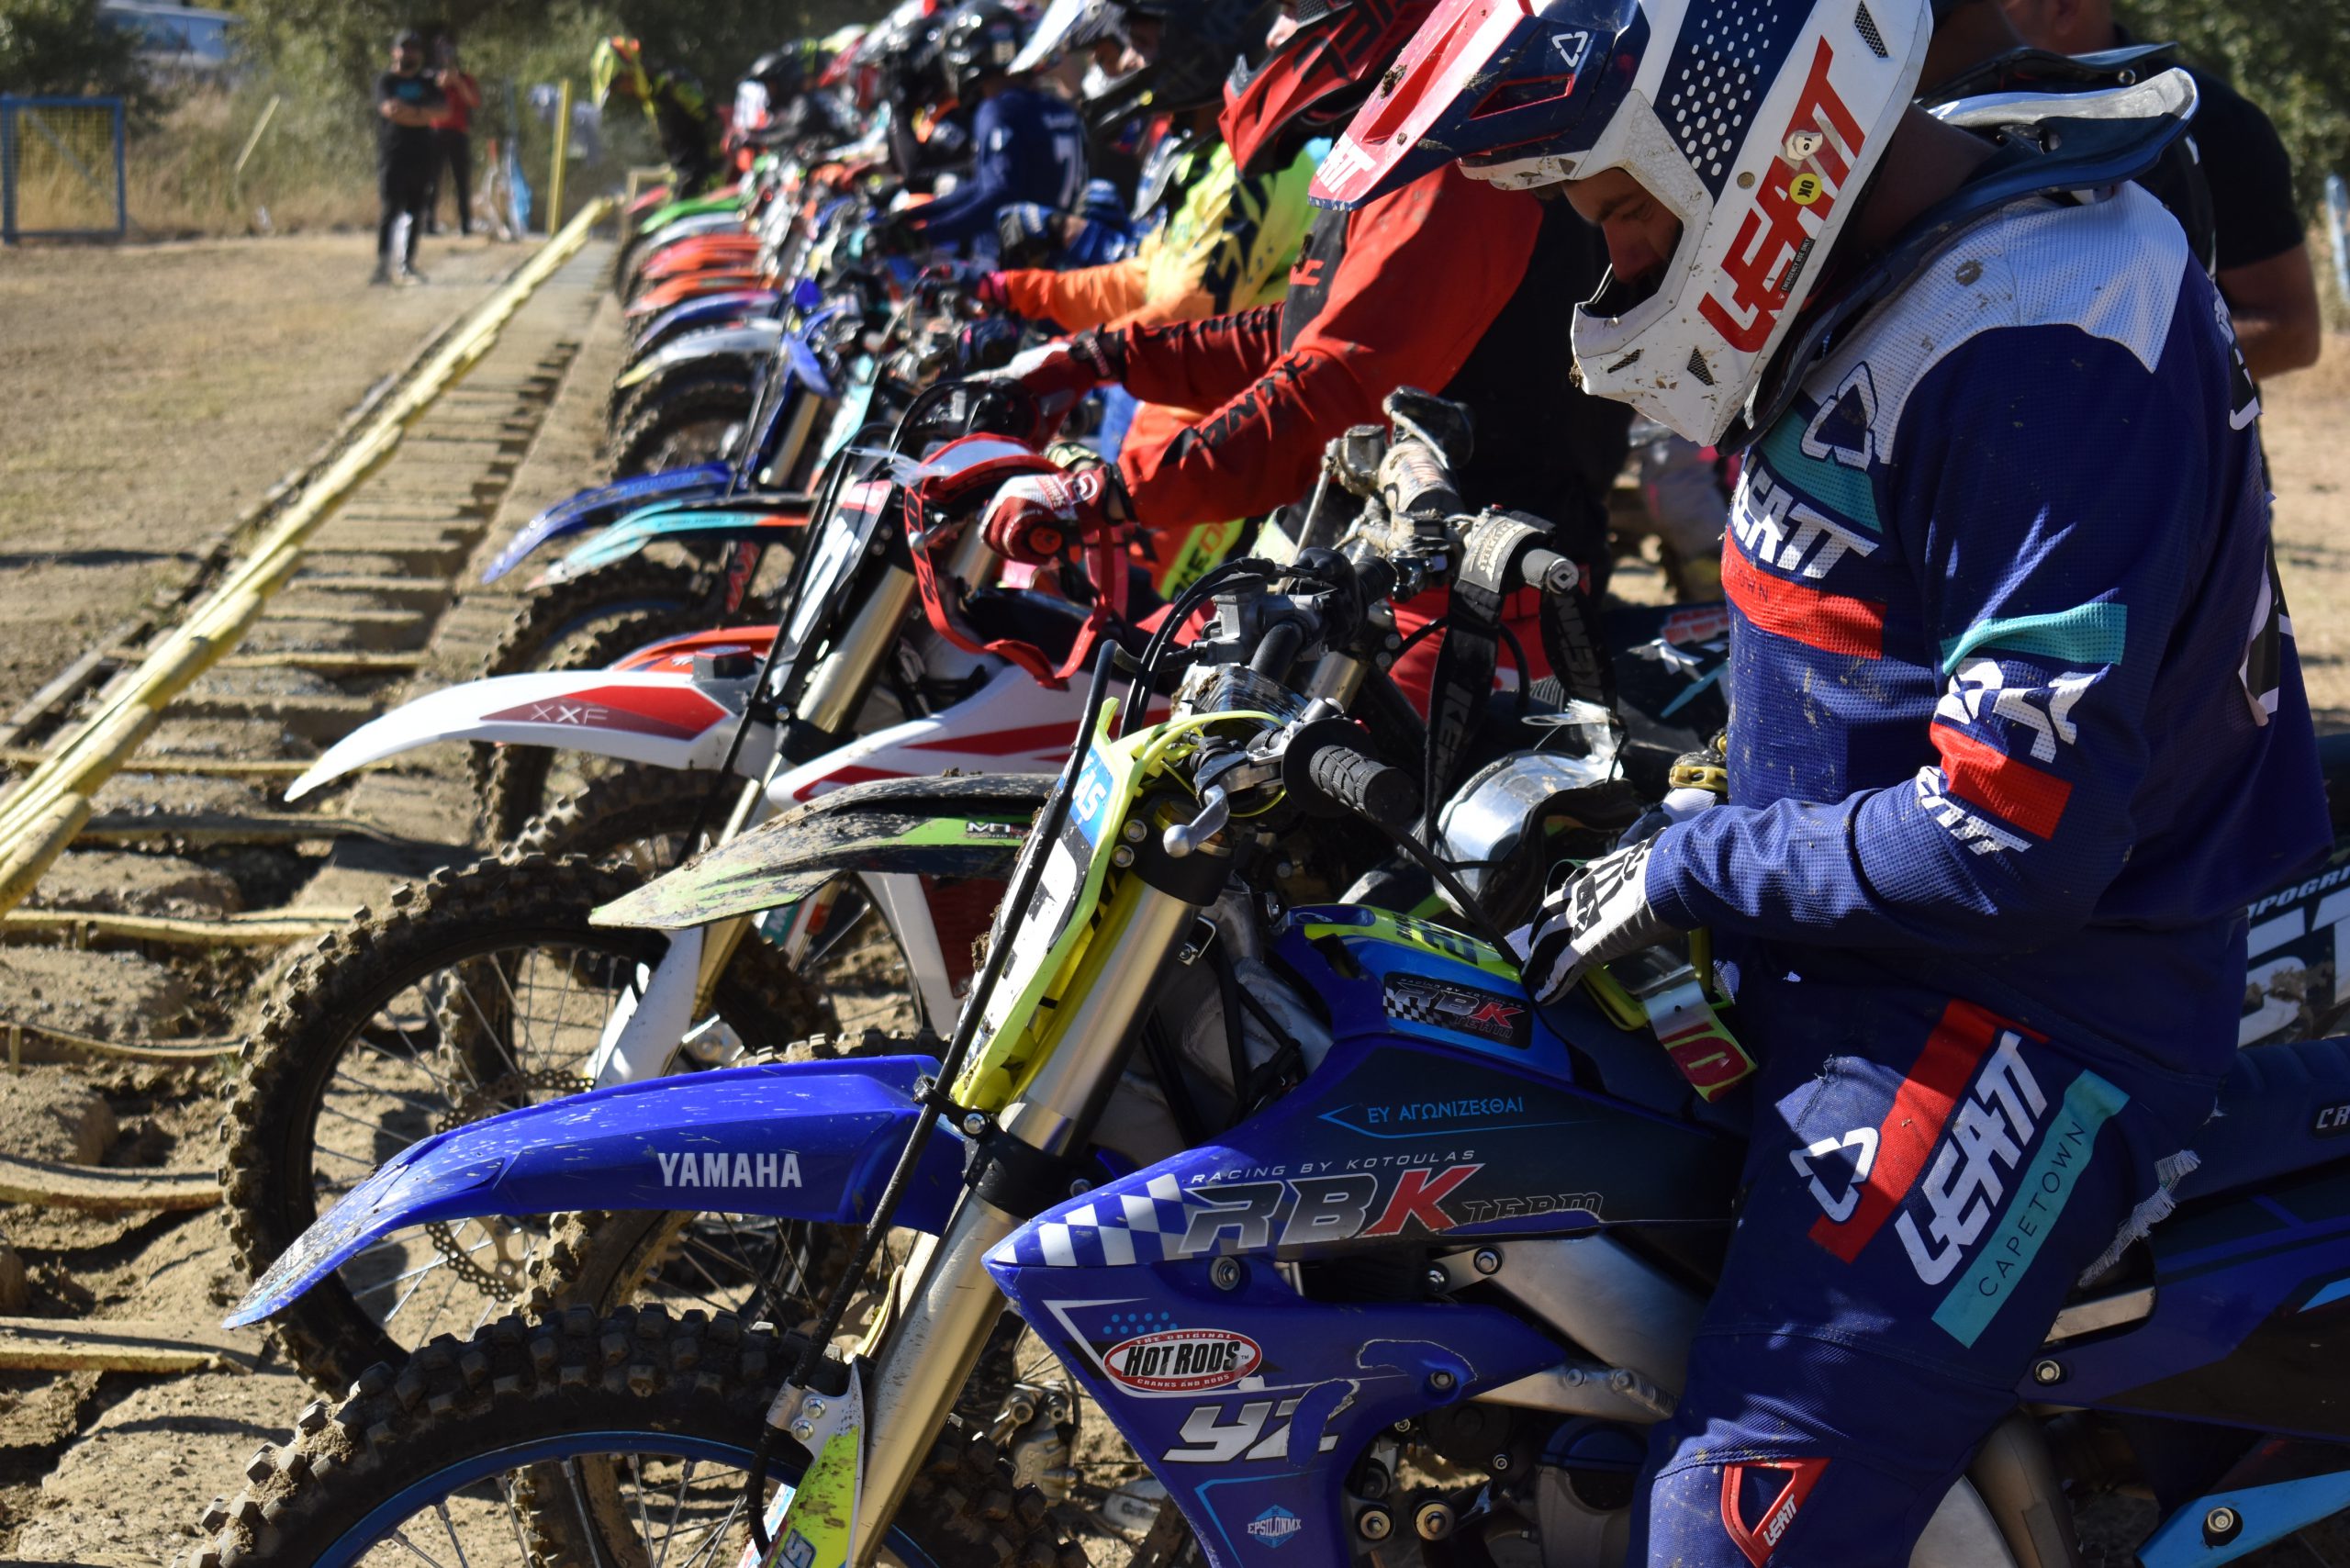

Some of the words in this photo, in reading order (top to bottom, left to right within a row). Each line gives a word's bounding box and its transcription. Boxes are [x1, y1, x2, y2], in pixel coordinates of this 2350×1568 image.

[1796, 178, 1816, 199] OK
[530, 703, 610, 726] XXF
[1396, 981, 1526, 1029] RBK
[657, 1152, 803, 1189] YAMAHA
[1192, 1165, 1286, 1184] RACING
[1300, 1161, 1334, 1174] BY
[1346, 1149, 1476, 1170] KOTOULAS
[1895, 1030, 2048, 1285] LEATT
[1178, 1162, 1486, 1253] RBK
[1978, 1121, 2087, 1297] CAPETOWN
[1136, 1336, 1160, 1345] THE
[1167, 1332, 1232, 1340] ORIGINAL
[1123, 1345, 1175, 1376] HOT
[1173, 1340, 1241, 1375] RODS
[1136, 1378, 1177, 1388] CRANKS
[1181, 1380, 1201, 1388] AND
[1203, 1373, 1230, 1385] RODS
[1248, 1516, 1302, 1538] EPSILONMX
[1762, 1493, 1797, 1547] LEATT
